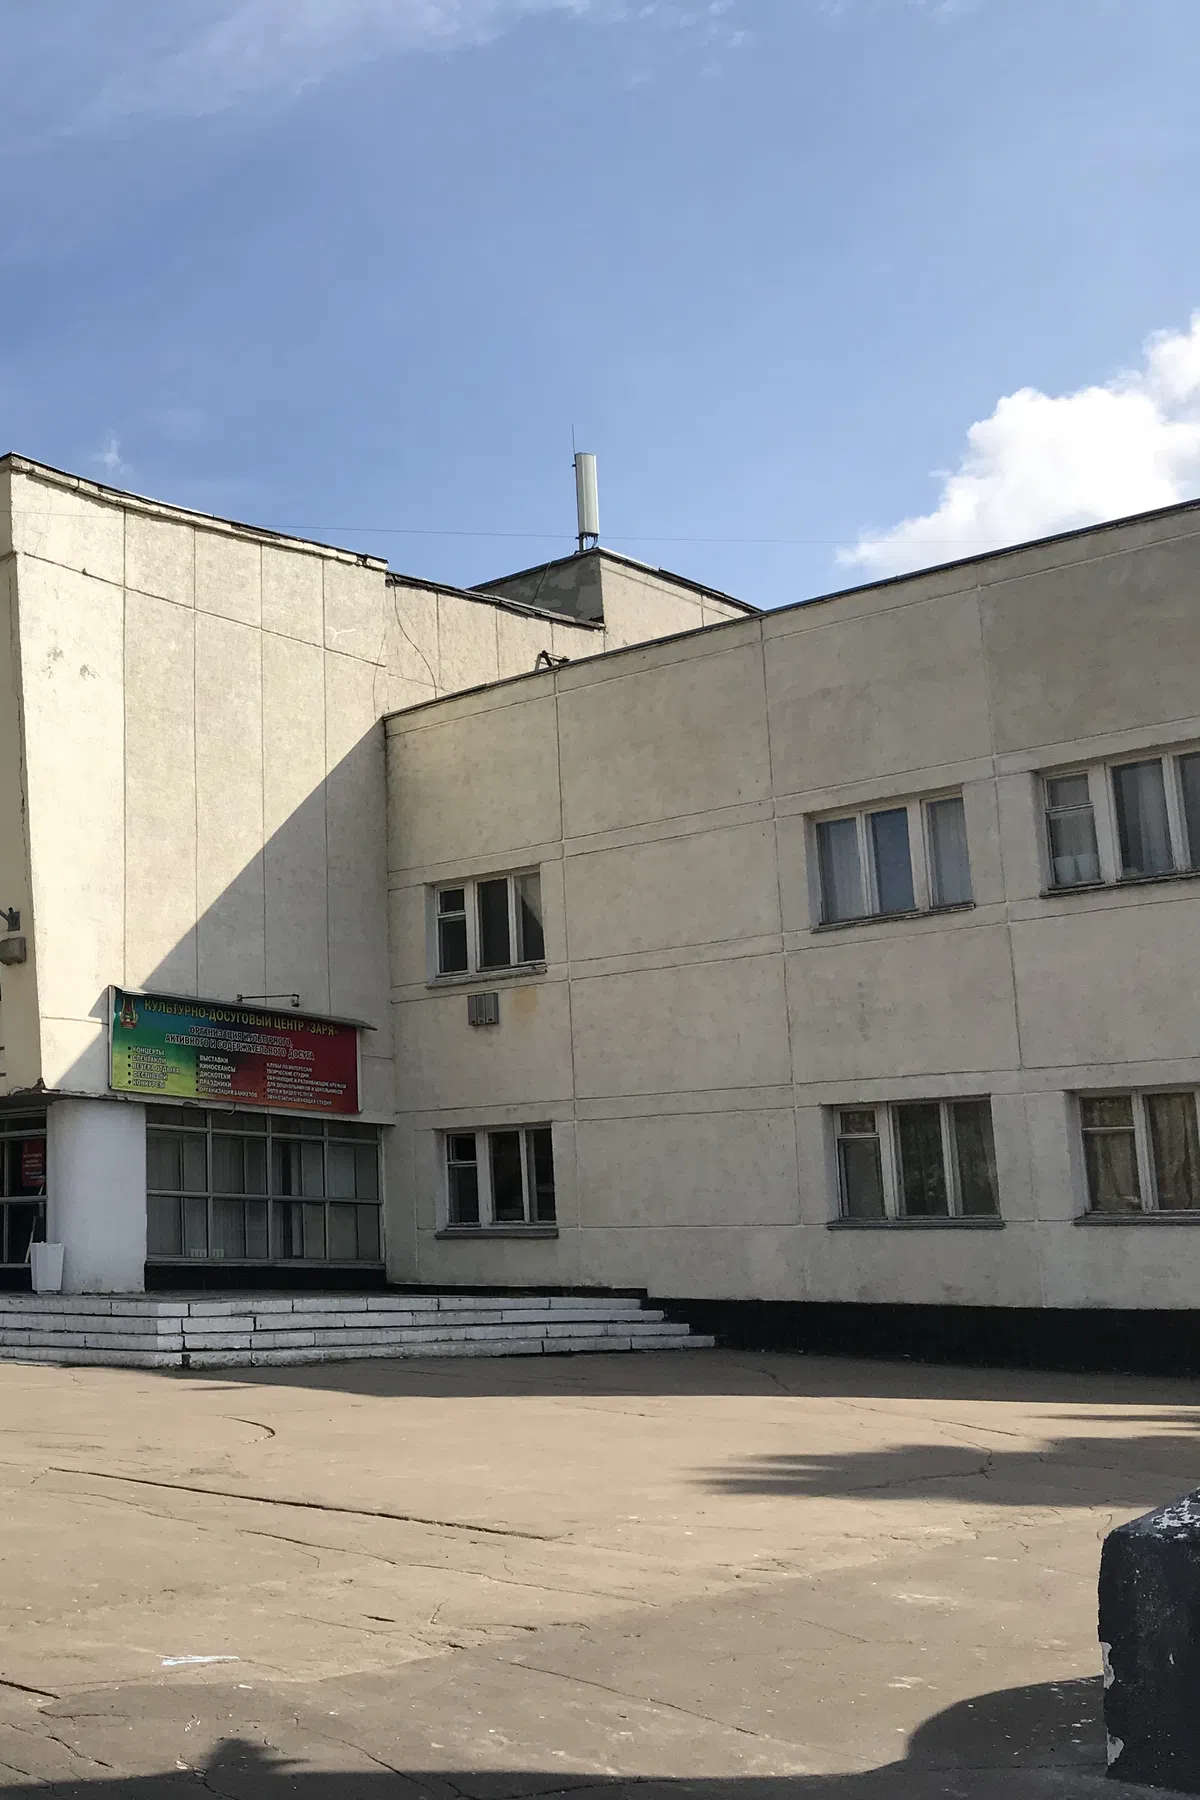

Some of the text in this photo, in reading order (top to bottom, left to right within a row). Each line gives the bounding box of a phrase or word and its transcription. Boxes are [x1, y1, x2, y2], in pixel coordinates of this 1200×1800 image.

[144, 1000, 272, 1028] КУЛЬТУРНО-ДОСУГОВЫЙ
[274, 1019, 304, 1031] ЦЕНТР
[189, 1025, 242, 1039] ОРГАНИЗАЦИЯ
[132, 1045, 165, 1056] КОНЦЕРТЫ
[165, 1033, 315, 1061] АКТИВНОГО И СОДЕРЖАТЕЛЬНОГО ДОСУГА
[199, 1054, 229, 1064] ВЫСТАВКИ
[132, 1062, 155, 1071] ВЕЧЕРА
[199, 1062, 236, 1072] КИНОСЕАНСЫ
[199, 1070, 231, 1080] ДИСКОТЕКИ
[132, 1079, 166, 1089] КОНКУРСЫ
[199, 1078, 232, 1088] ПРАЗДНИКИ
